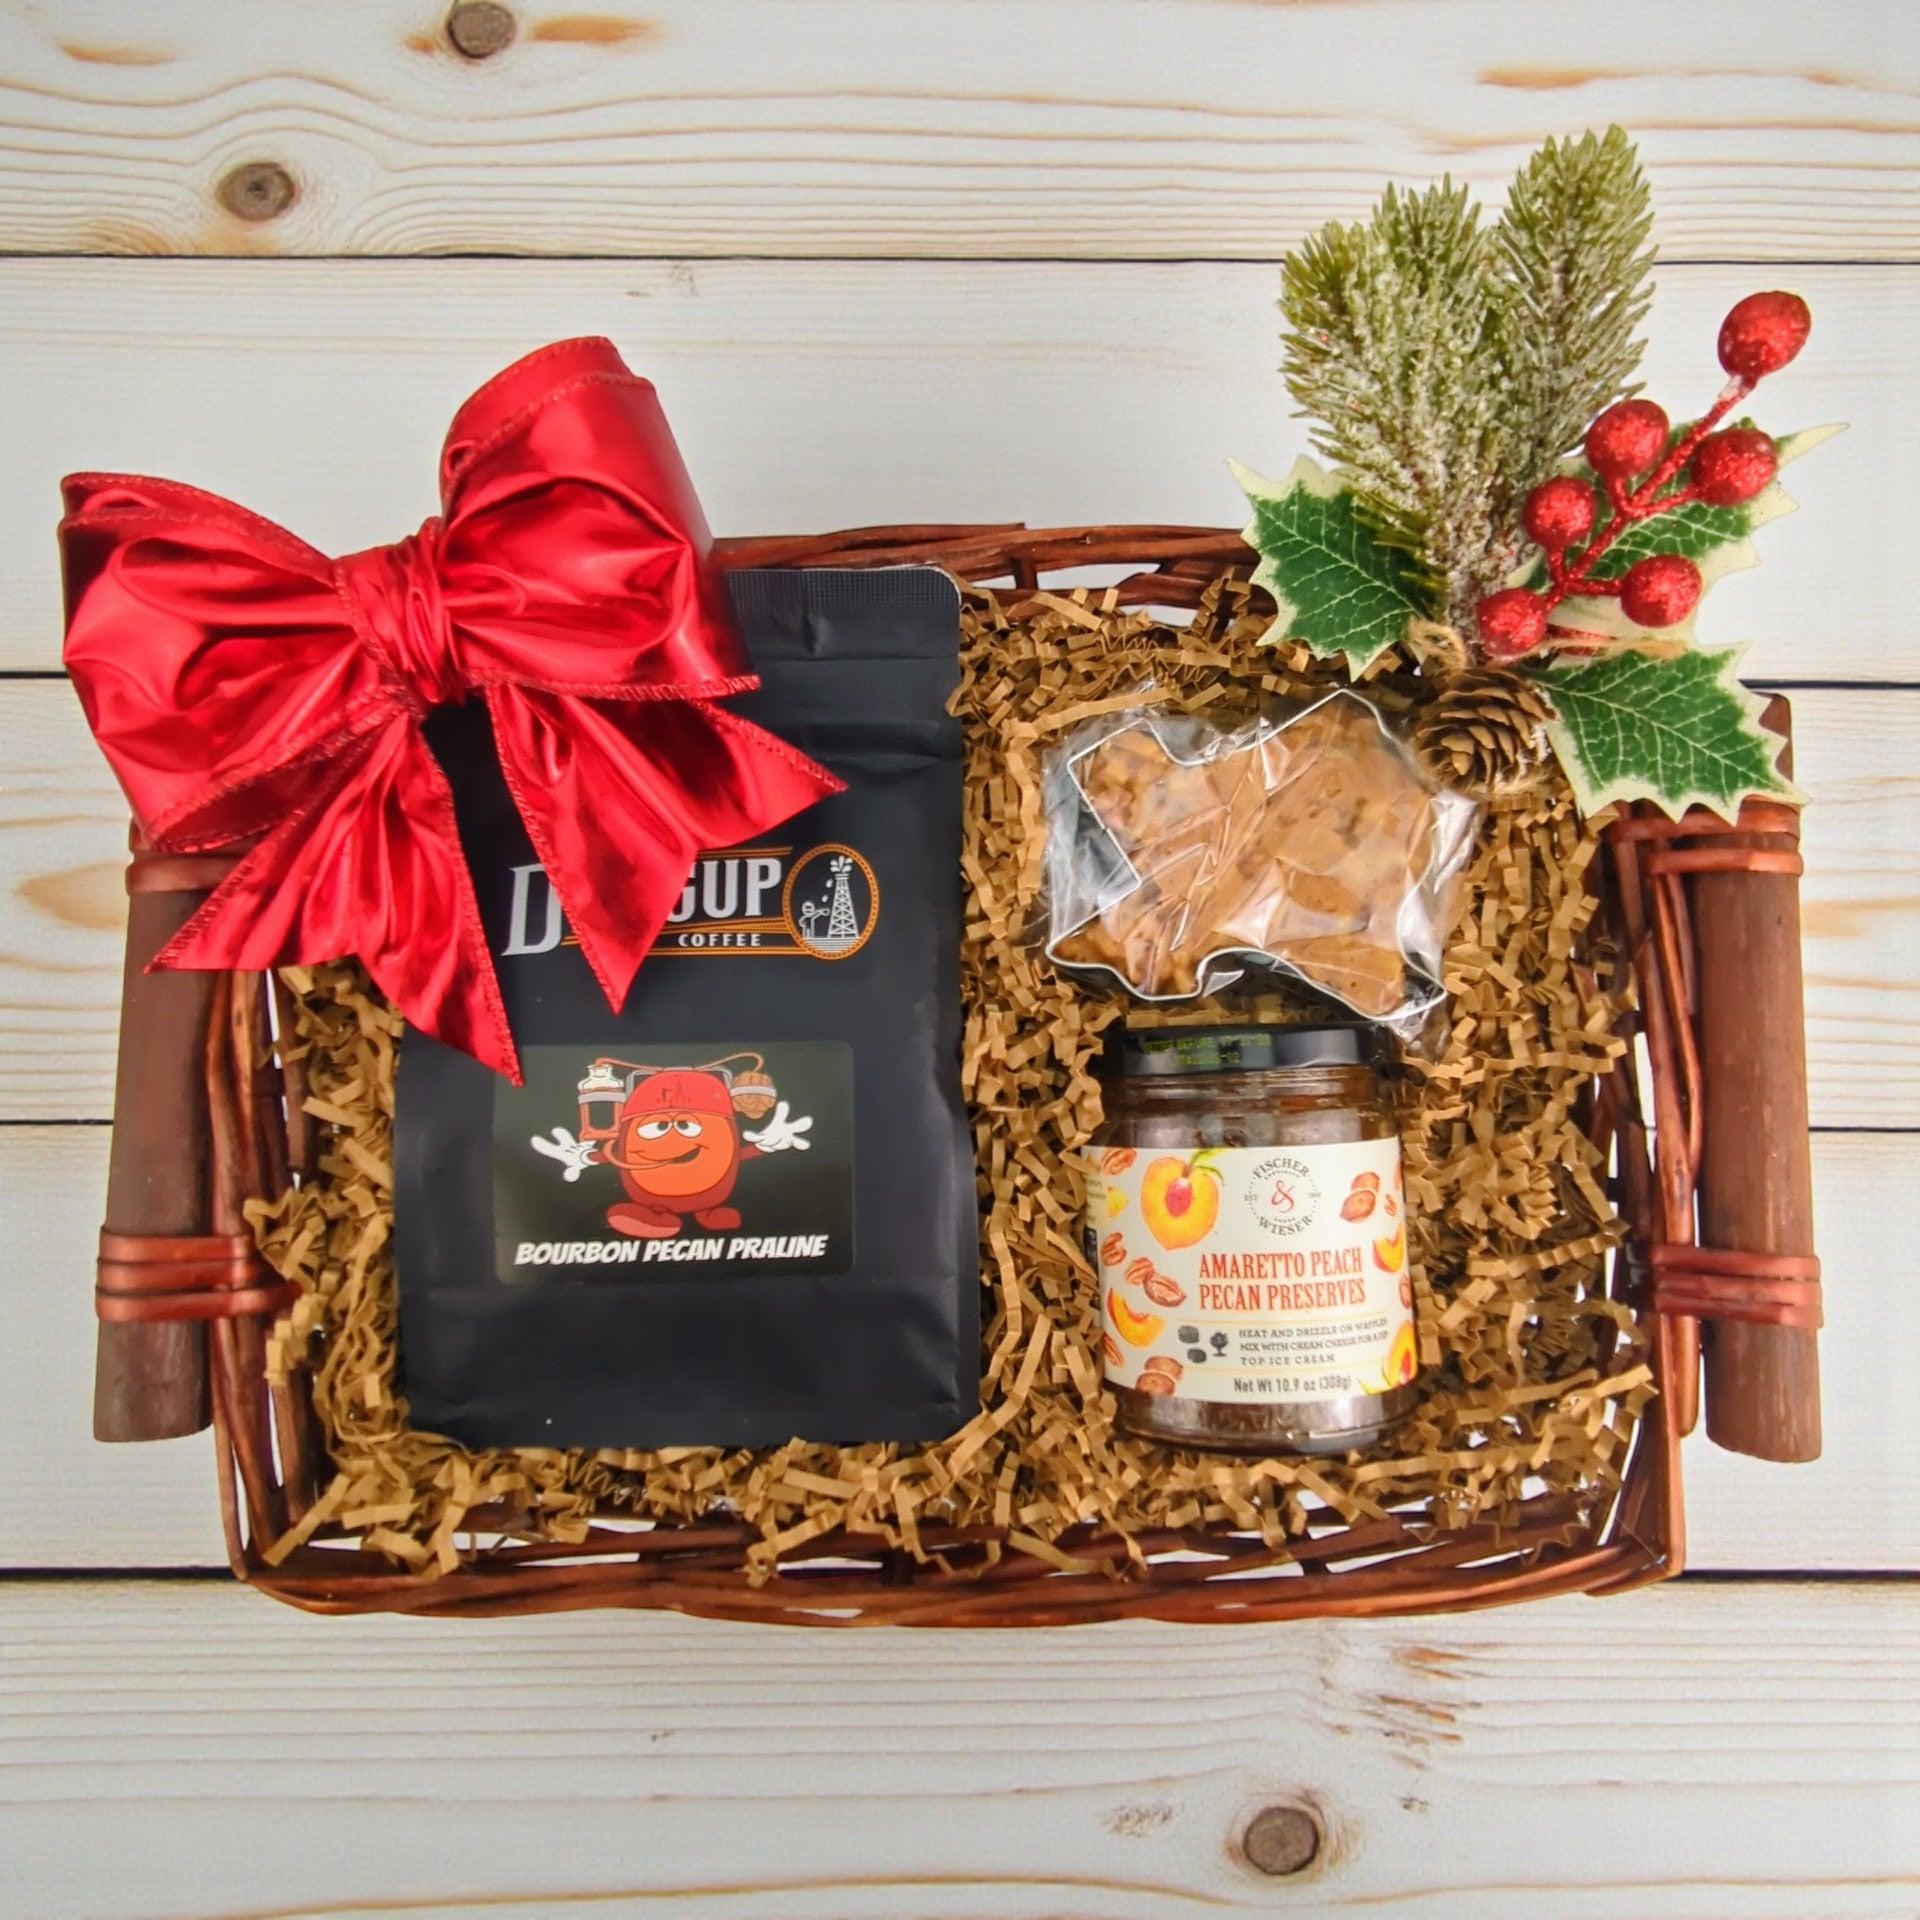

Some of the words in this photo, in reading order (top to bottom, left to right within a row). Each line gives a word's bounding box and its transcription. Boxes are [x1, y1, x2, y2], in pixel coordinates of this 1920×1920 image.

[678, 933, 761, 947] COFFEE
[1252, 1157, 1310, 1179] FISCHER
[1259, 1215, 1313, 1236] WIESER
[514, 1239, 640, 1265] BOURBON
[641, 1237, 725, 1262] PECAN
[726, 1234, 829, 1260] PRALINE
[1199, 1252, 1306, 1279] AMARETTO
[1310, 1246, 1363, 1277] PEACH
[1199, 1283, 1261, 1310] PECAN
[1266, 1278, 1366, 1310] PRESERVES
[1239, 1328, 1268, 1338] HEAT
[1269, 1328, 1295, 1338] AND
[1240, 1342, 1260, 1352] MIX
[1261, 1341, 1289, 1351] WITH
[1289, 1339, 1325, 1351] CREAM
[1239, 1356, 1265, 1366] TOP
[1269, 1356, 1290, 1366] ICE
[1294, 1354, 1336, 1365] CREAM
[1233, 1377, 1254, 1393] Net
[1256, 1377, 1272, 1393] Wt
[1275, 1376, 1300, 1393] 10.9
[1302, 1379, 1316, 1392] oz
